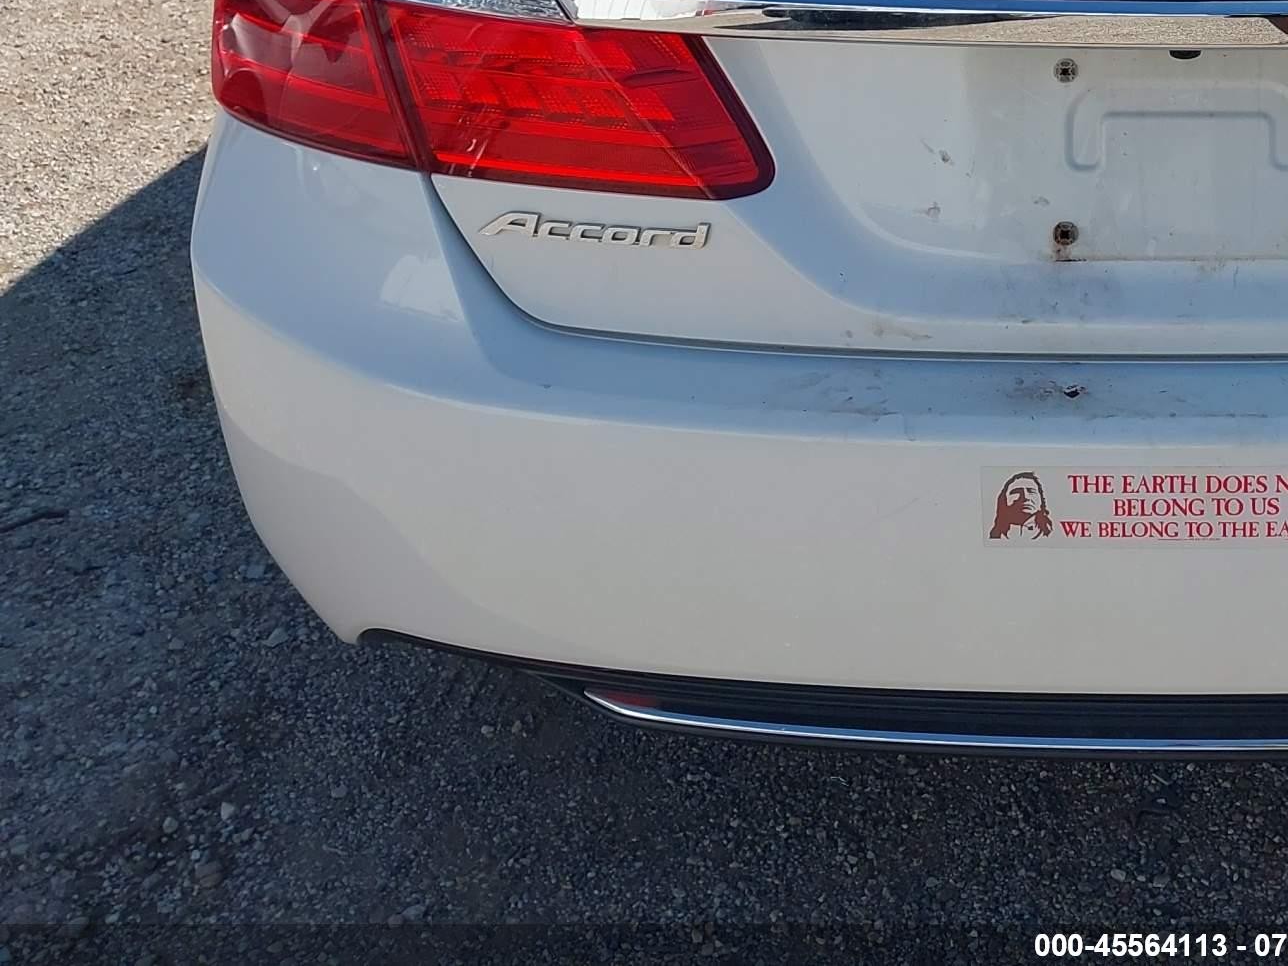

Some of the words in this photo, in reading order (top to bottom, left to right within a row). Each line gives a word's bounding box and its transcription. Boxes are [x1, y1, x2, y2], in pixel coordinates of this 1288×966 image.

[479, 210, 711, 248] Accord
[1068, 474, 1112, 495] THE
[1121, 474, 1199, 495] EARTH
[1206, 474, 1269, 495] DOES
[1113, 498, 1206, 518] BELONG
[1212, 497, 1246, 517] TO
[1250, 498, 1280, 518] US
[1059, 521, 1090, 539] WE
[1098, 521, 1179, 539] BELONG
[1185, 521, 1215, 539] TO
[1220, 521, 1258, 539] THE
